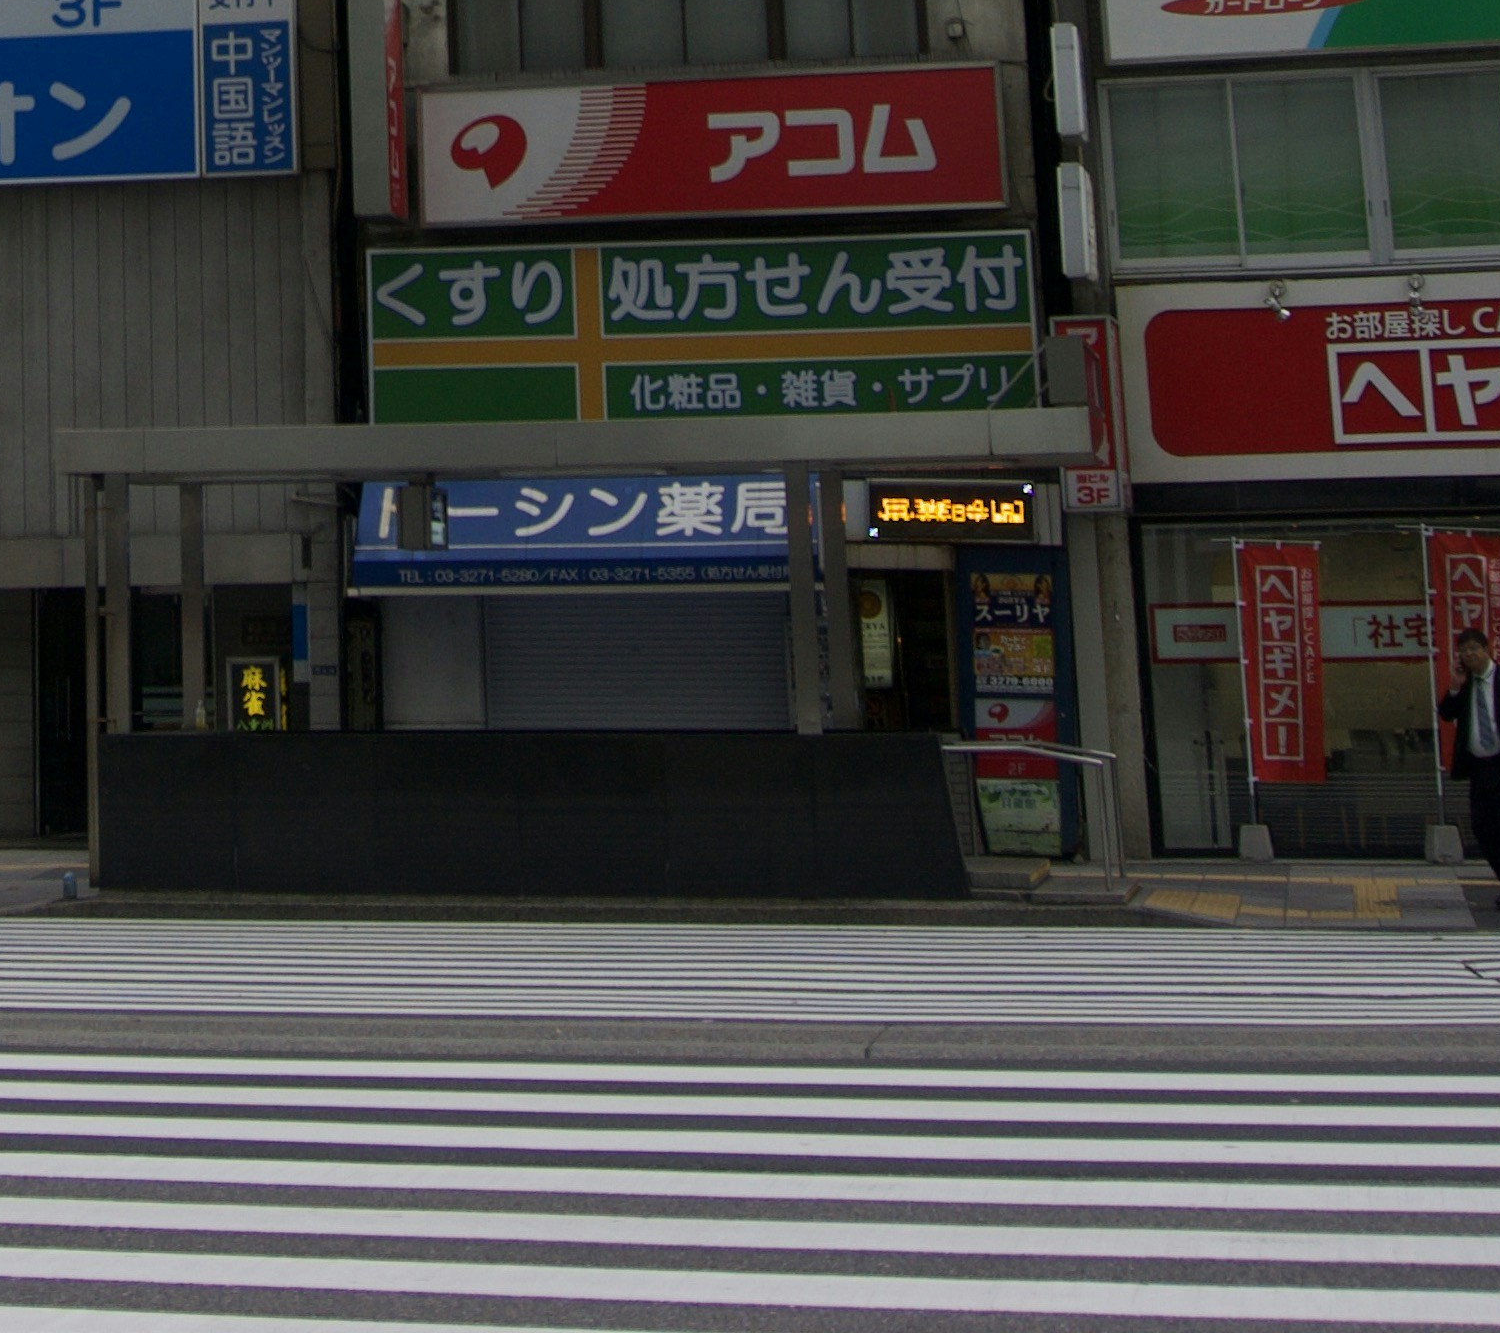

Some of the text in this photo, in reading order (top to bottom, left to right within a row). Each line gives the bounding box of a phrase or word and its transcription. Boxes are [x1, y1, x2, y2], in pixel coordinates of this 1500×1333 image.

[210, 31, 256, 168] 中国語
[706, 103, 938, 184] アコム
[375, 258, 566, 329] くすり
[608, 245, 1024, 323] 処方せん受付
[1325, 309, 1467, 340] お部屋探し
[629, 365, 1012, 413] 化粧品・雑貨・サプリ
[1077, 486, 1110, 504] 3F
[974, 604, 1051, 623] スーリヤ
